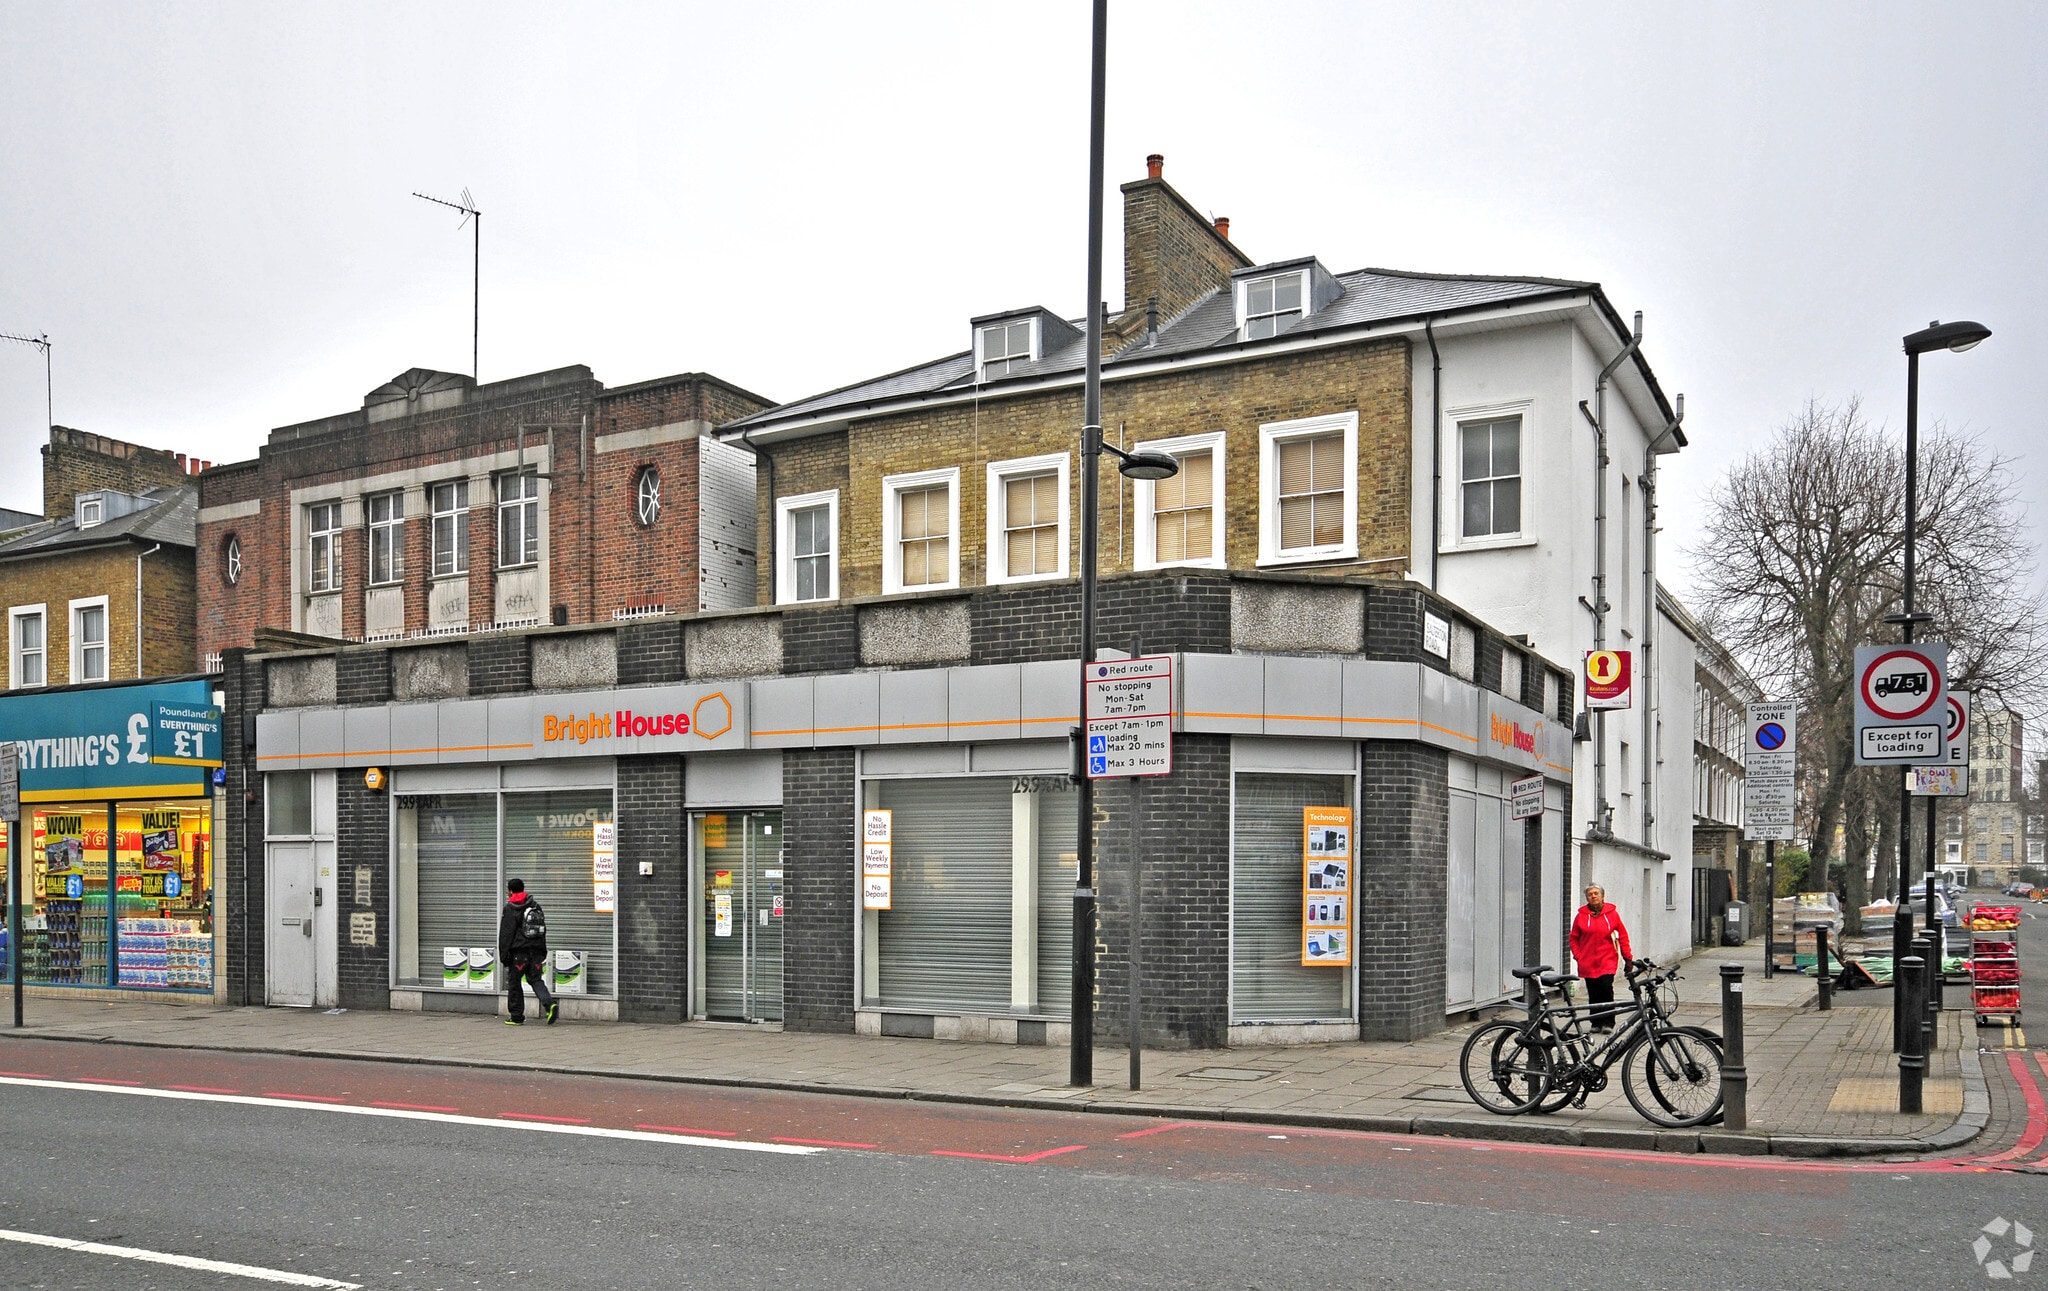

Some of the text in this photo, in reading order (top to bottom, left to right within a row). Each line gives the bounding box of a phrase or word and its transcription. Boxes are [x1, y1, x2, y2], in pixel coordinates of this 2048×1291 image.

[1110, 664, 1153, 674] Red route
[1114, 681, 1152, 691] stopping
[160, 706, 206, 718] Poundland
[1751, 704, 1792, 712] Controlled
[1756, 712, 1785, 720] ZONE
[160, 720, 218, 732] EVERYTHING'S
[1089, 722, 1118, 732] Except
[1107, 734, 1138, 742] loading
[1868, 730, 1933, 741] Except for
[174, 730, 204, 758] £1
[1107, 741, 1165, 752] Max 20 mins
[1878, 742, 1924, 752] loading
[1107, 758, 1165, 768] Max 3 Hours
[1518, 780, 1542, 792] RED ROUTE
[1522, 796, 1540, 806] stopping
[142, 812, 180, 829] VALUE!
[1310, 814, 1346, 822] Technology
[46, 816, 82, 834] WOW!
[866, 855, 888, 863] Weekly
[143, 876, 152, 885] TRY
[68, 879, 80, 894] £1
[166, 878, 178, 894] £1
[866, 891, 887, 899] Deposit
